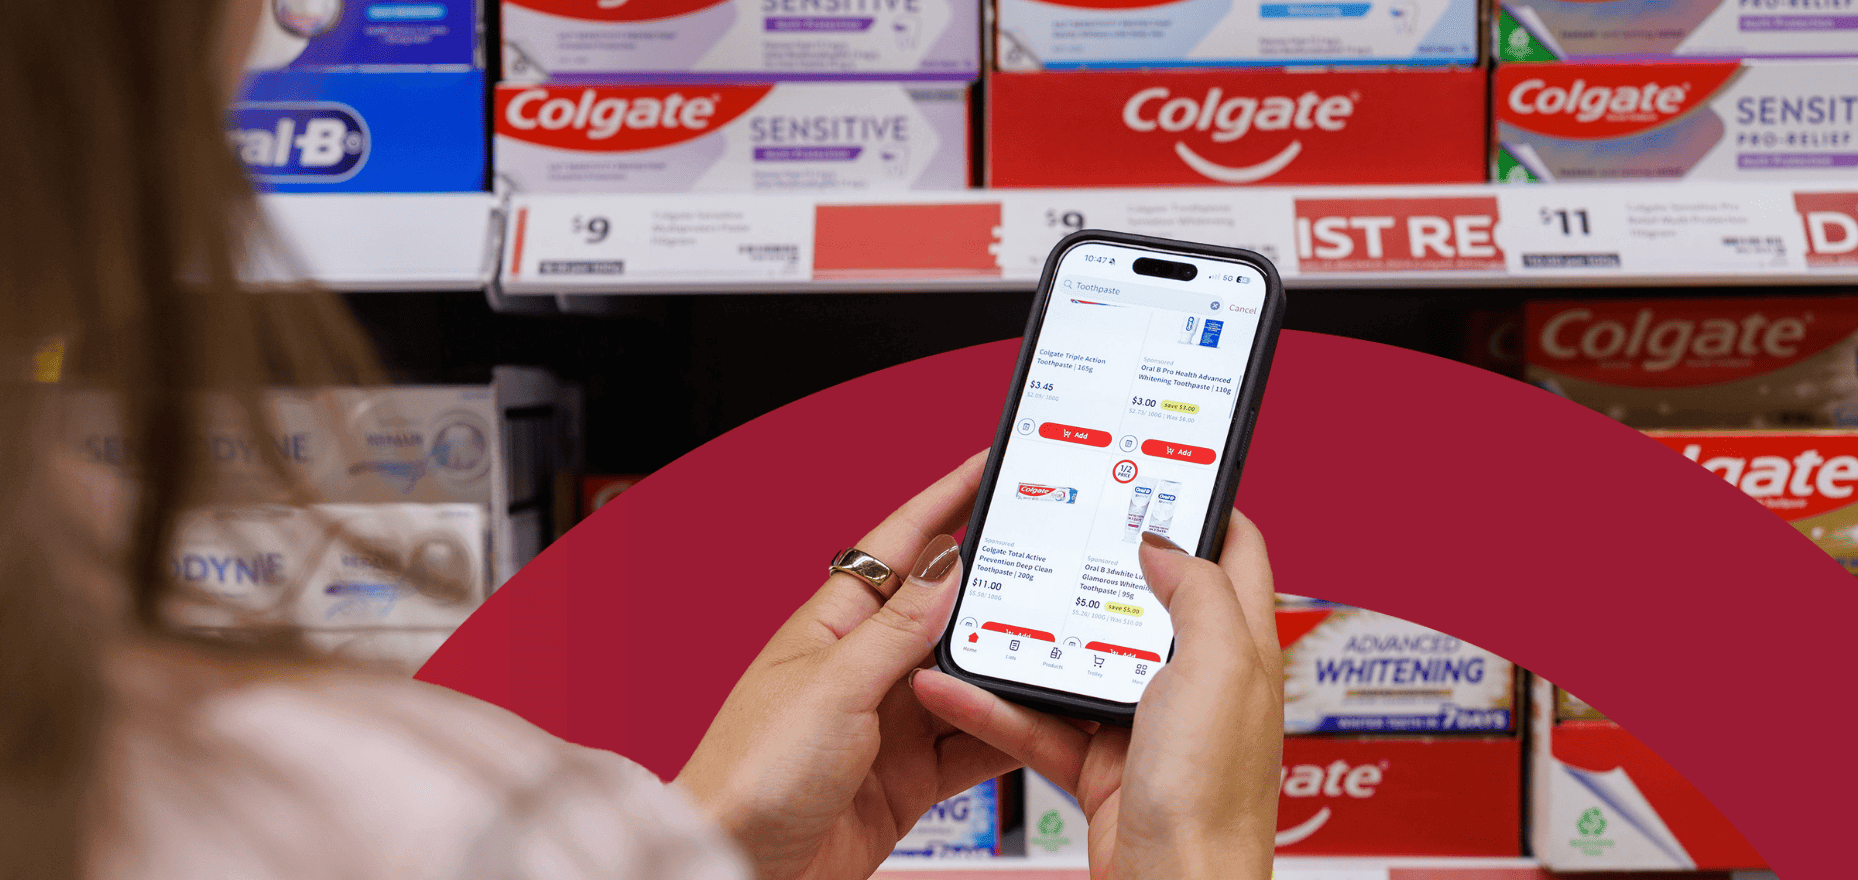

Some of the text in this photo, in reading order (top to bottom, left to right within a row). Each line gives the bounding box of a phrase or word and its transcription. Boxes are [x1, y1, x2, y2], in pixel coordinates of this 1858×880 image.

[1508, 79, 1686, 122] Colgate
[505, 88, 716, 139] Colgate
[1122, 86, 1354, 142] Colgate
[1736, 96, 1858, 125] SENSIT
[749, 115, 908, 142] SENSITIVE
[223, 117, 347, 167] al-B
[1737, 133, 1852, 146] PRO-RELIEF
[1540, 206, 1590, 237] $11
[1299, 214, 1500, 260] IST RE
[1084, 254, 1108, 265] 10:47
[1222, 274, 1234, 282] 5G
[1076, 281, 1121, 296] Toothpaste
[1229, 304, 1257, 315] Cancel
[1541, 308, 1806, 371] Colgate
[1039, 348, 1106, 365] Colgate Triple Action
[1037, 358, 1073, 371] Toothpaste
[1077, 364, 1094, 374] 165g
[1140, 364, 1156, 374] Oral
[1162, 368, 1175, 376] Pro
[1175, 369, 1198, 380] Health
[1198, 372, 1232, 384] Advanced
[1030, 380, 1054, 392] $3.45
[1138, 373, 1172, 386] Whitening
[1173, 378, 1211, 391] Toothpaste
[1215, 386, 1232, 396] 110g
[1131, 396, 1157, 408] $3.00
[1164, 402, 1178, 410] save
[1074, 431, 1088, 440] Add
[1178, 449, 1192, 457] Add
[1117, 471, 1131, 479] PRICE
[1119, 464, 1133, 474] 1/2
[1020, 485, 1051, 495] Colgate
[984, 537, 1015, 548] Sponsored
[981, 545, 1047, 563] Colgate Total Active
[1087, 555, 1119, 567] Sponsored
[172, 552, 283, 585] DYNE
[979, 554, 1053, 574] Prevention Deep Clean
[1084, 563, 1145, 580] Oral B 3dwhite Lu
[977, 563, 1013, 577] Toothpaste
[1017, 571, 1034, 582] 200g
[1082, 573, 1120, 587] Glamorous
[972, 577, 1002, 592] $11.00
[1080, 582, 1117, 596] Toothpaste
[1121, 590, 1135, 600] 95g
[1075, 596, 1100, 609] $5.00
[1108, 603, 1122, 611] save
[1110, 615, 1122, 624] Was
[962, 646, 977, 654] Home
[1345, 633, 1460, 654] ADVANCED
[1042, 661, 1064, 670] Products
[1316, 657, 1484, 684] WHITENING
[1087, 669, 1103, 679] Trolley
[1280, 759, 1382, 798] ate
